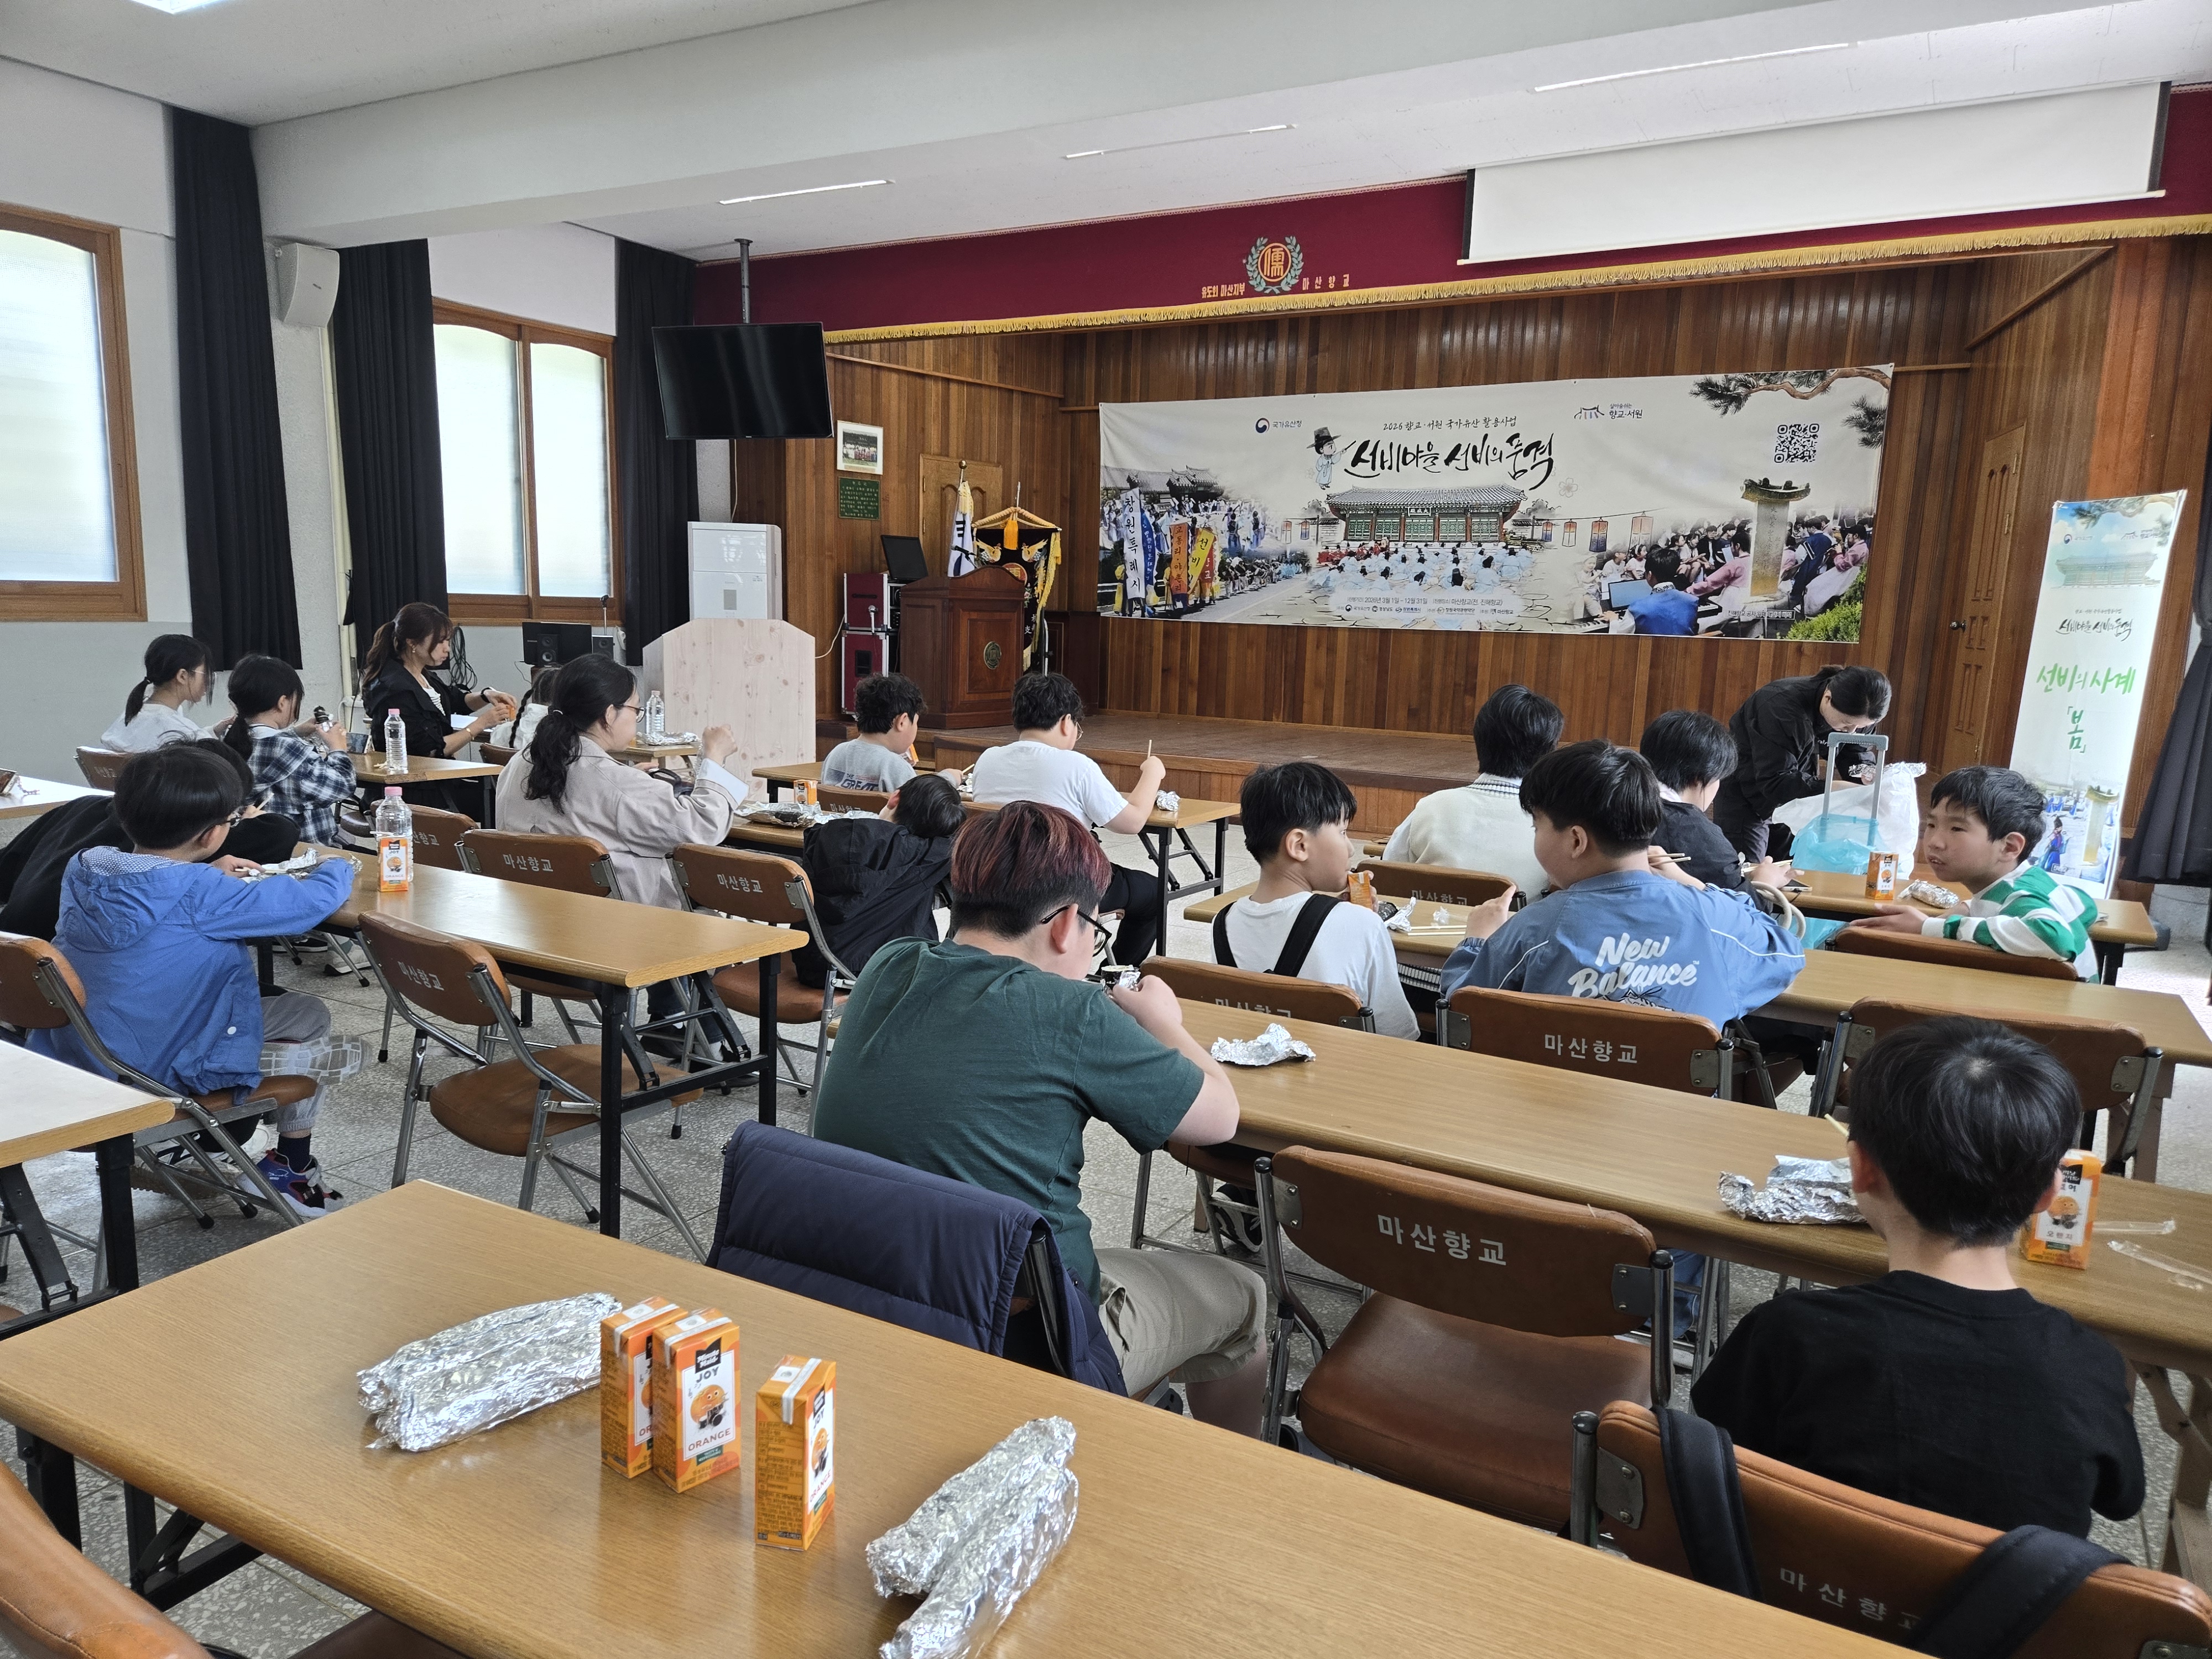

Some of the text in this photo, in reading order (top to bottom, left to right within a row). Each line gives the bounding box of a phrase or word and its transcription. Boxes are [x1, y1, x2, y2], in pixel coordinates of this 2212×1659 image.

[1201, 283, 1245, 299] 유도회 마산지부
[1272, 420, 1302, 429] 국가유산청
[1383, 422, 1403, 431] 2026
[1446, 419, 1480, 430] 국가유산
[1482, 416, 1517, 429] 활용사업
[1609, 409, 1643, 420] 향교·서원
[1344, 432, 1554, 491] 선비마을 선비의 품격
[2036, 662, 2136, 695] 선비의 사계
[841, 778, 879, 791] GREAT
[503, 854, 554, 872] 마산향교
[717, 873, 763, 893] 마산향교
[1594, 932, 1670, 967] New
[398, 961, 445, 991] 마산향교
[1567, 961, 1698, 998] Balance
[1545, 1034, 1637, 1064] 마산향교
[696, 1366, 719, 1383] JOY
[688, 1427, 731, 1452] ORANGE
[810, 1469, 831, 1503] ORANGE
